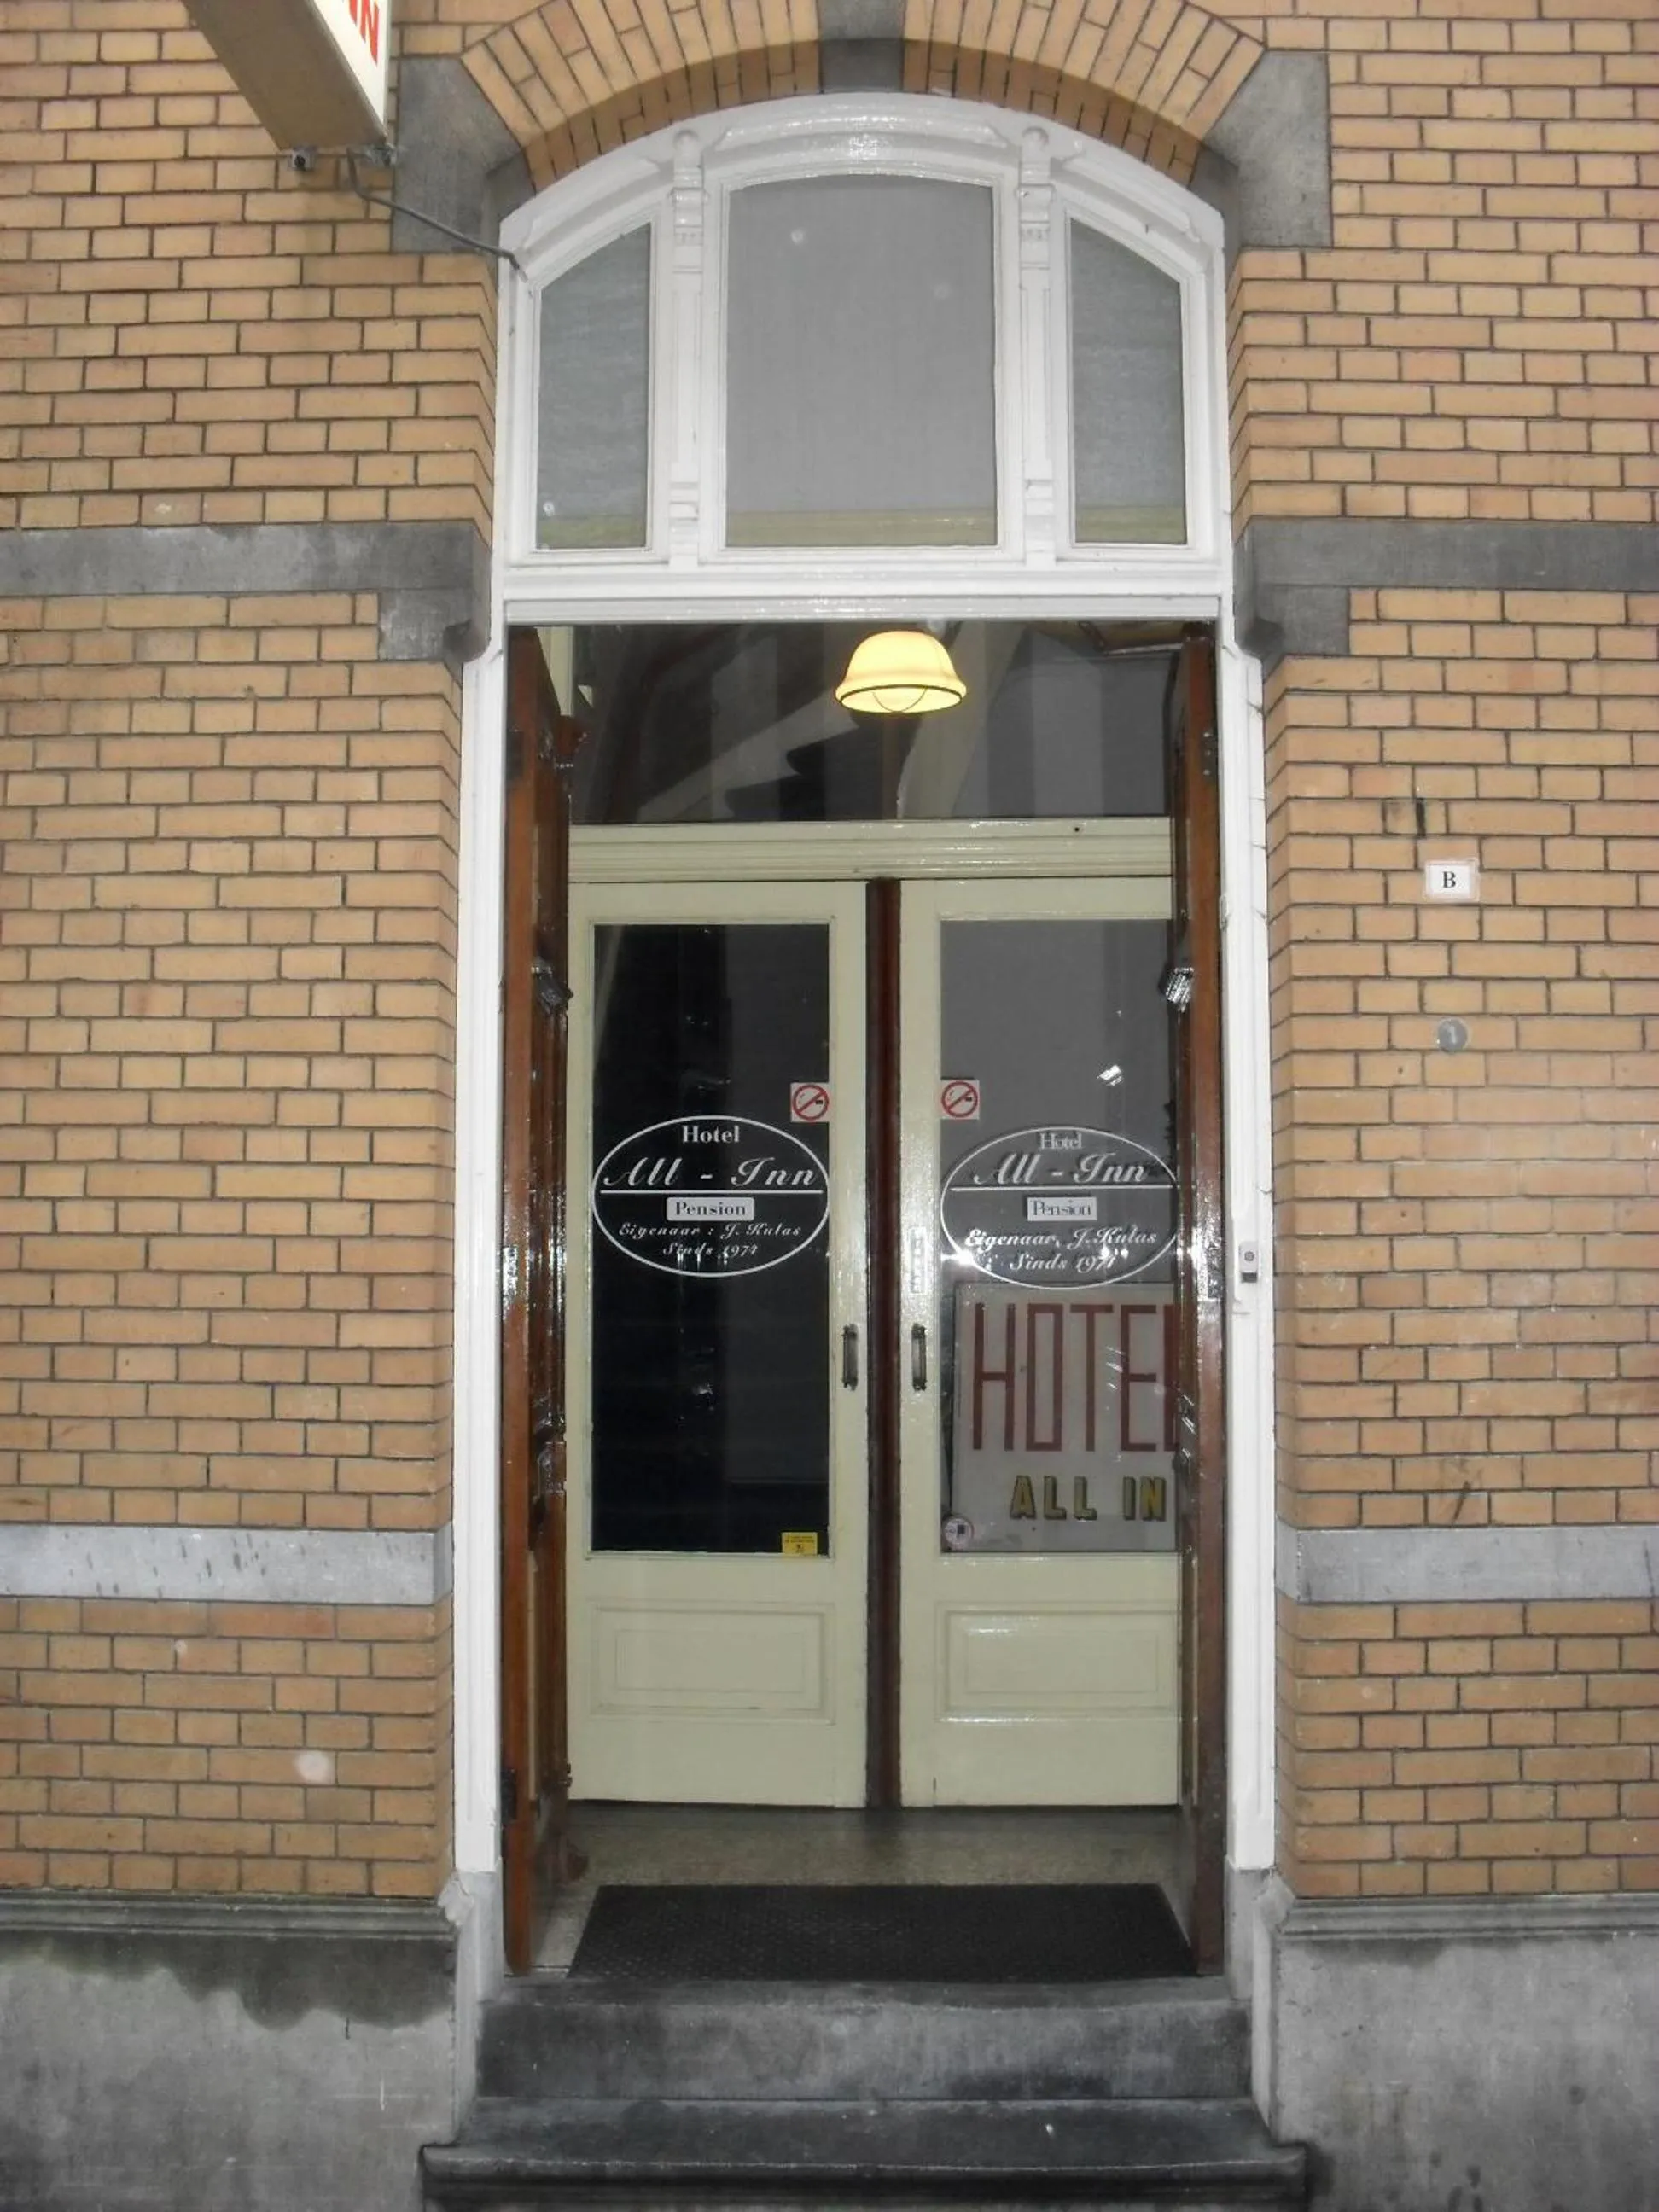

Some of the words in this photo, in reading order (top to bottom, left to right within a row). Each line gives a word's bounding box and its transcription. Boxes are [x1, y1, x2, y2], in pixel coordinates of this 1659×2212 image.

[1442, 870, 1456, 888] B
[683, 1125, 740, 1144] Hotel
[1039, 1132, 1083, 1150] Hotel
[603, 1157, 683, 1186] All
[731, 1156, 816, 1187] Inn
[973, 1153, 1041, 1185] All
[1073, 1152, 1149, 1184] Inn
[675, 1201, 747, 1216] Pension
[1033, 1200, 1091, 1216] Pension
[1009, 1253, 1067, 1271] Sinds
[1010, 1476, 1097, 1521] ALL
[1122, 1476, 1167, 1522] IN
